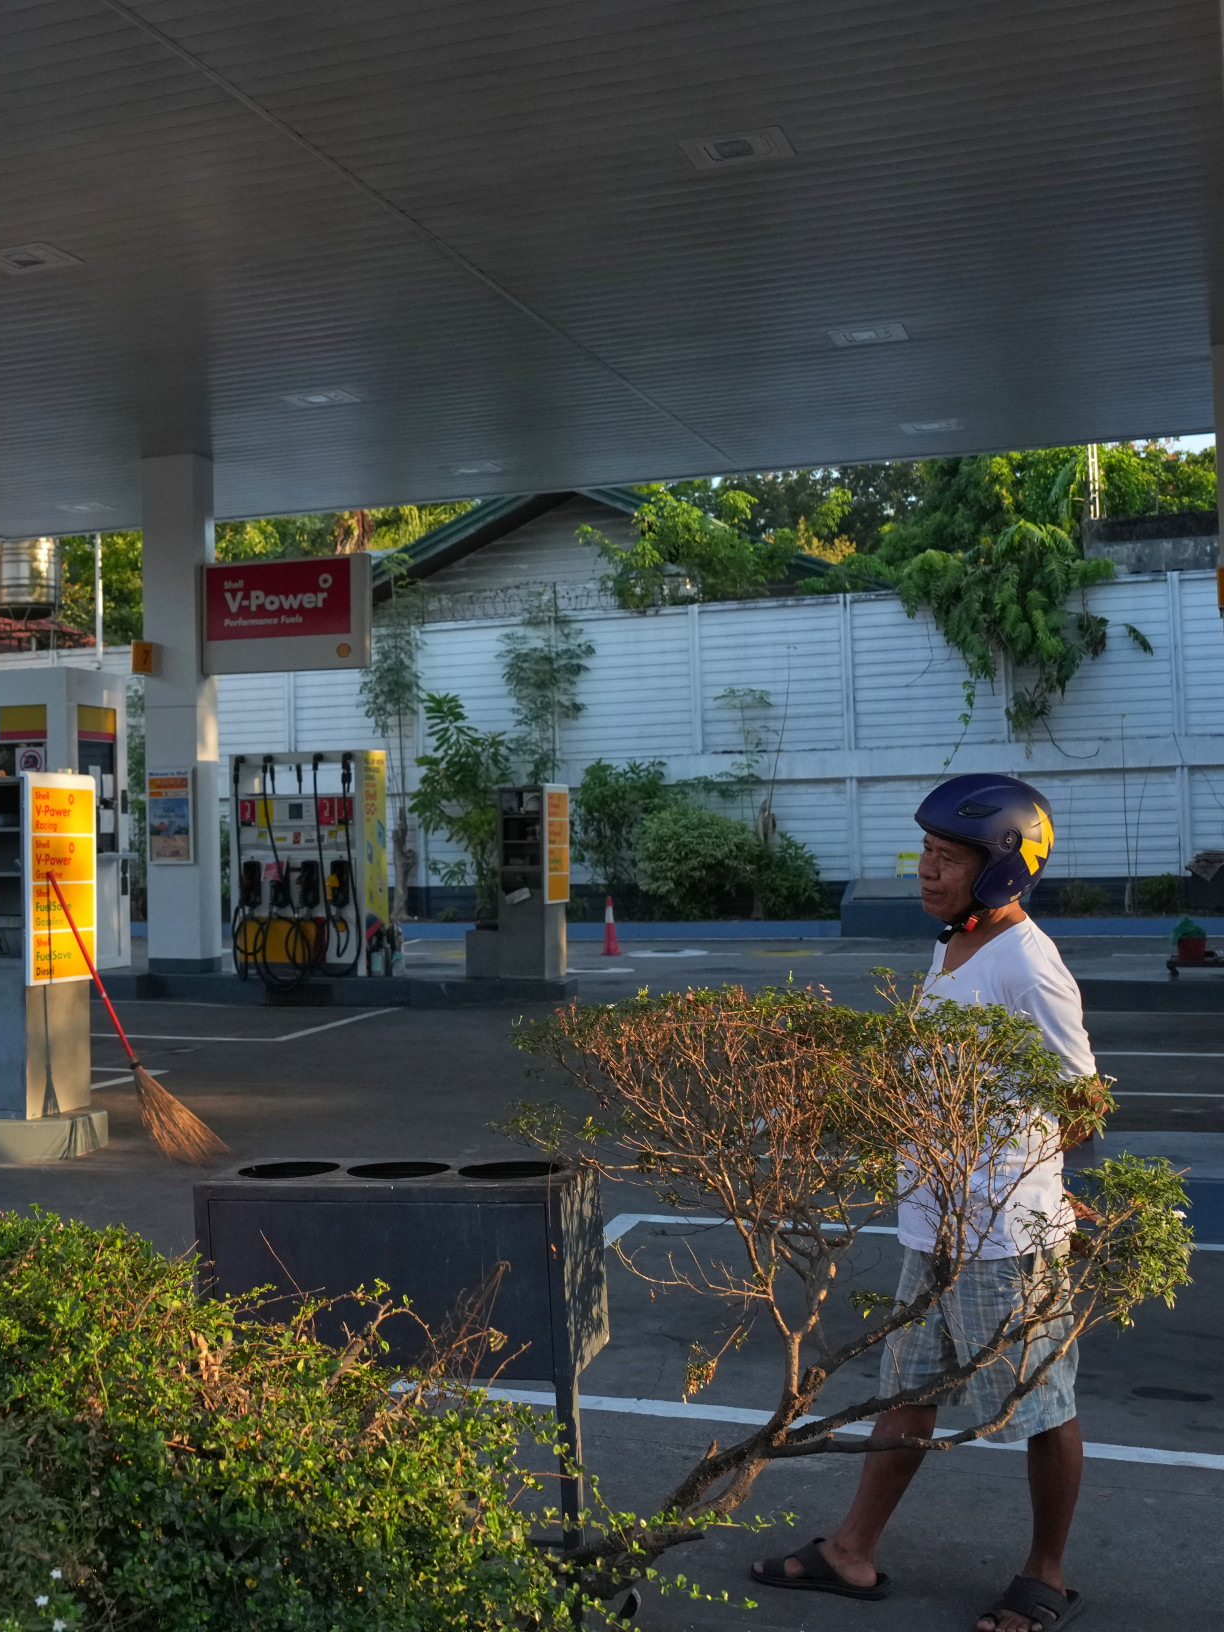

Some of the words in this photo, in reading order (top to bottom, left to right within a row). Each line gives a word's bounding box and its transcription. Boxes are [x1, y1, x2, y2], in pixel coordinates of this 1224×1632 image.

[224, 579, 244, 590] Shell
[224, 590, 328, 613] V-Power
[224, 616, 278, 627] Performance
[280, 614, 303, 624] Fuels
[35, 791, 50, 800] Shell
[36, 804, 71, 817] V-Power
[36, 820, 57, 832] Racing
[35, 840, 50, 849] Shell
[36, 853, 71, 865] V-Power
[36, 901, 72, 912] FuelSae
[36, 950, 72, 962] FuelSave
[36, 965, 55, 976] Diesel
